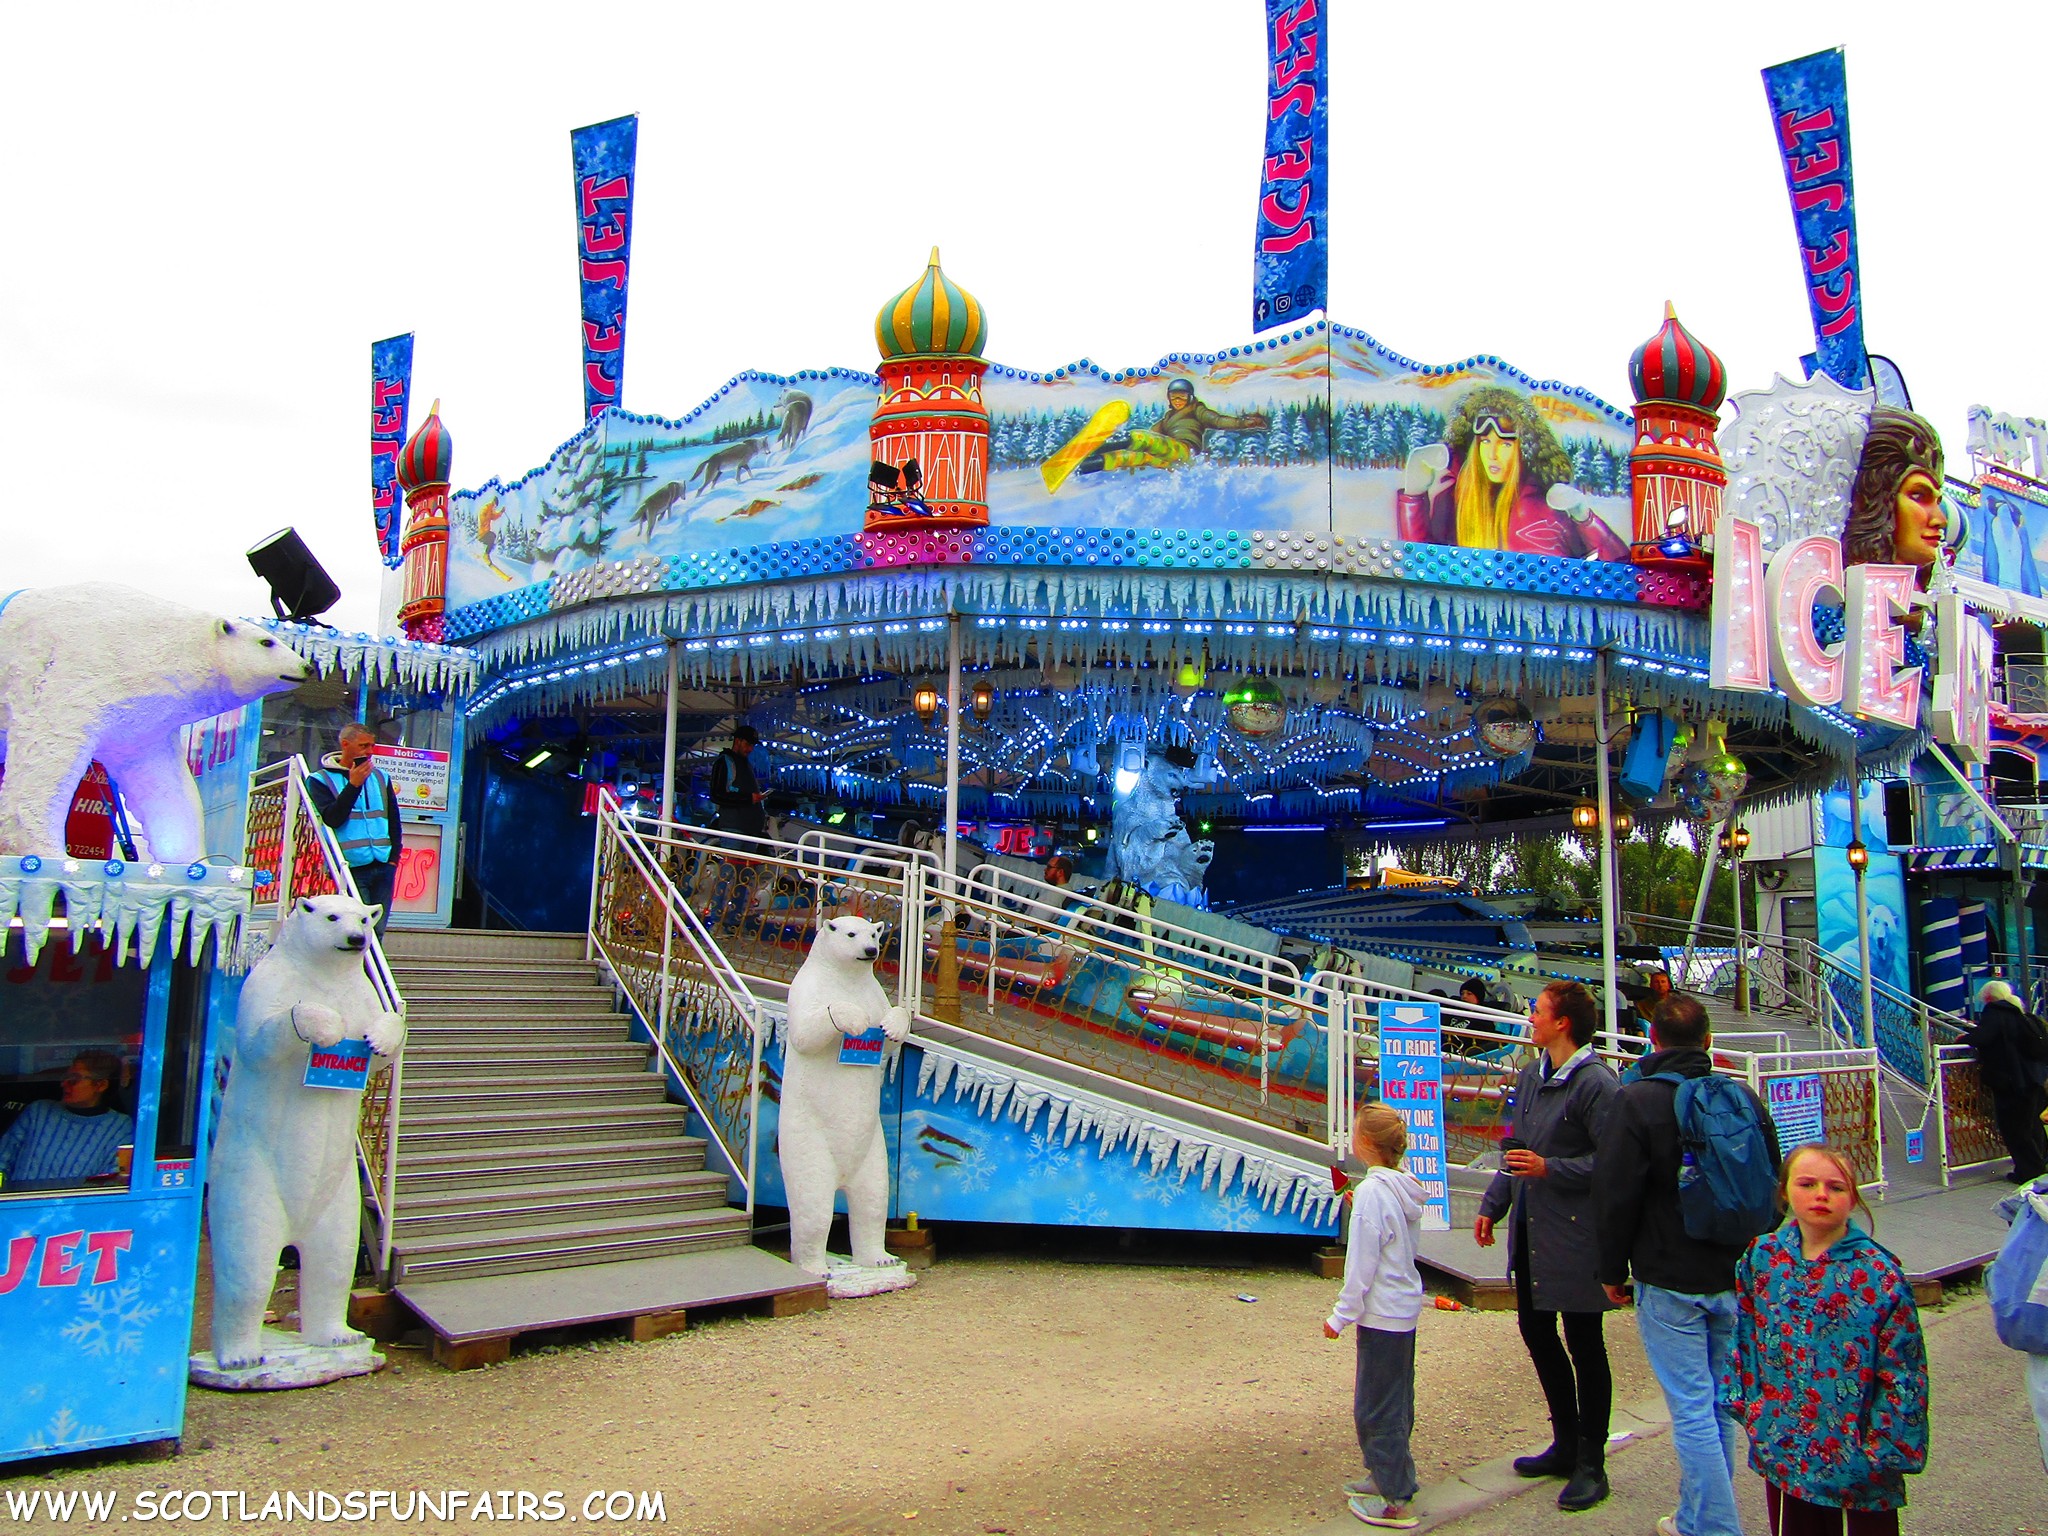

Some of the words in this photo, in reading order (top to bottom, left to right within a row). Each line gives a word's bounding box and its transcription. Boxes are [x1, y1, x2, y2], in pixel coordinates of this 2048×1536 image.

[1270, 0, 1318, 120] JET
[1779, 107, 1844, 212] JET
[1261, 137, 1312, 253] ICE
[581, 176, 629, 290] JET
[1804, 229, 1855, 337] ICE
[372, 379, 403, 463] JET
[1709, 515, 1922, 729] ICE
[393, 749, 425, 759] Notice
[404, 760, 417, 768] fast
[418, 761, 432, 769] ride
[407, 769, 435, 777] stopped
[74, 844, 105, 856] 722454
[843, 1038, 883, 1052] ENTRANCE
[1384, 1039, 1402, 1055] TO
[310, 1052, 369, 1072] ENTRANCE
[1397, 1060, 1424, 1077] The
[1384, 1080, 1407, 1099] ICE
[1411, 1080, 1439, 1100] JET
[1770, 1082, 1793, 1102] ICE
[1796, 1078, 1818, 1099] JET
[1413, 1109, 1435, 1127] ONE
[1418, 1133, 1439, 1151] 1.2m
[156, 1161, 191, 1172] FARE
[1412, 1156, 1425, 1174] TO
[1425, 1156, 1438, 1174] BE
[0, 1228, 134, 1295] JET
